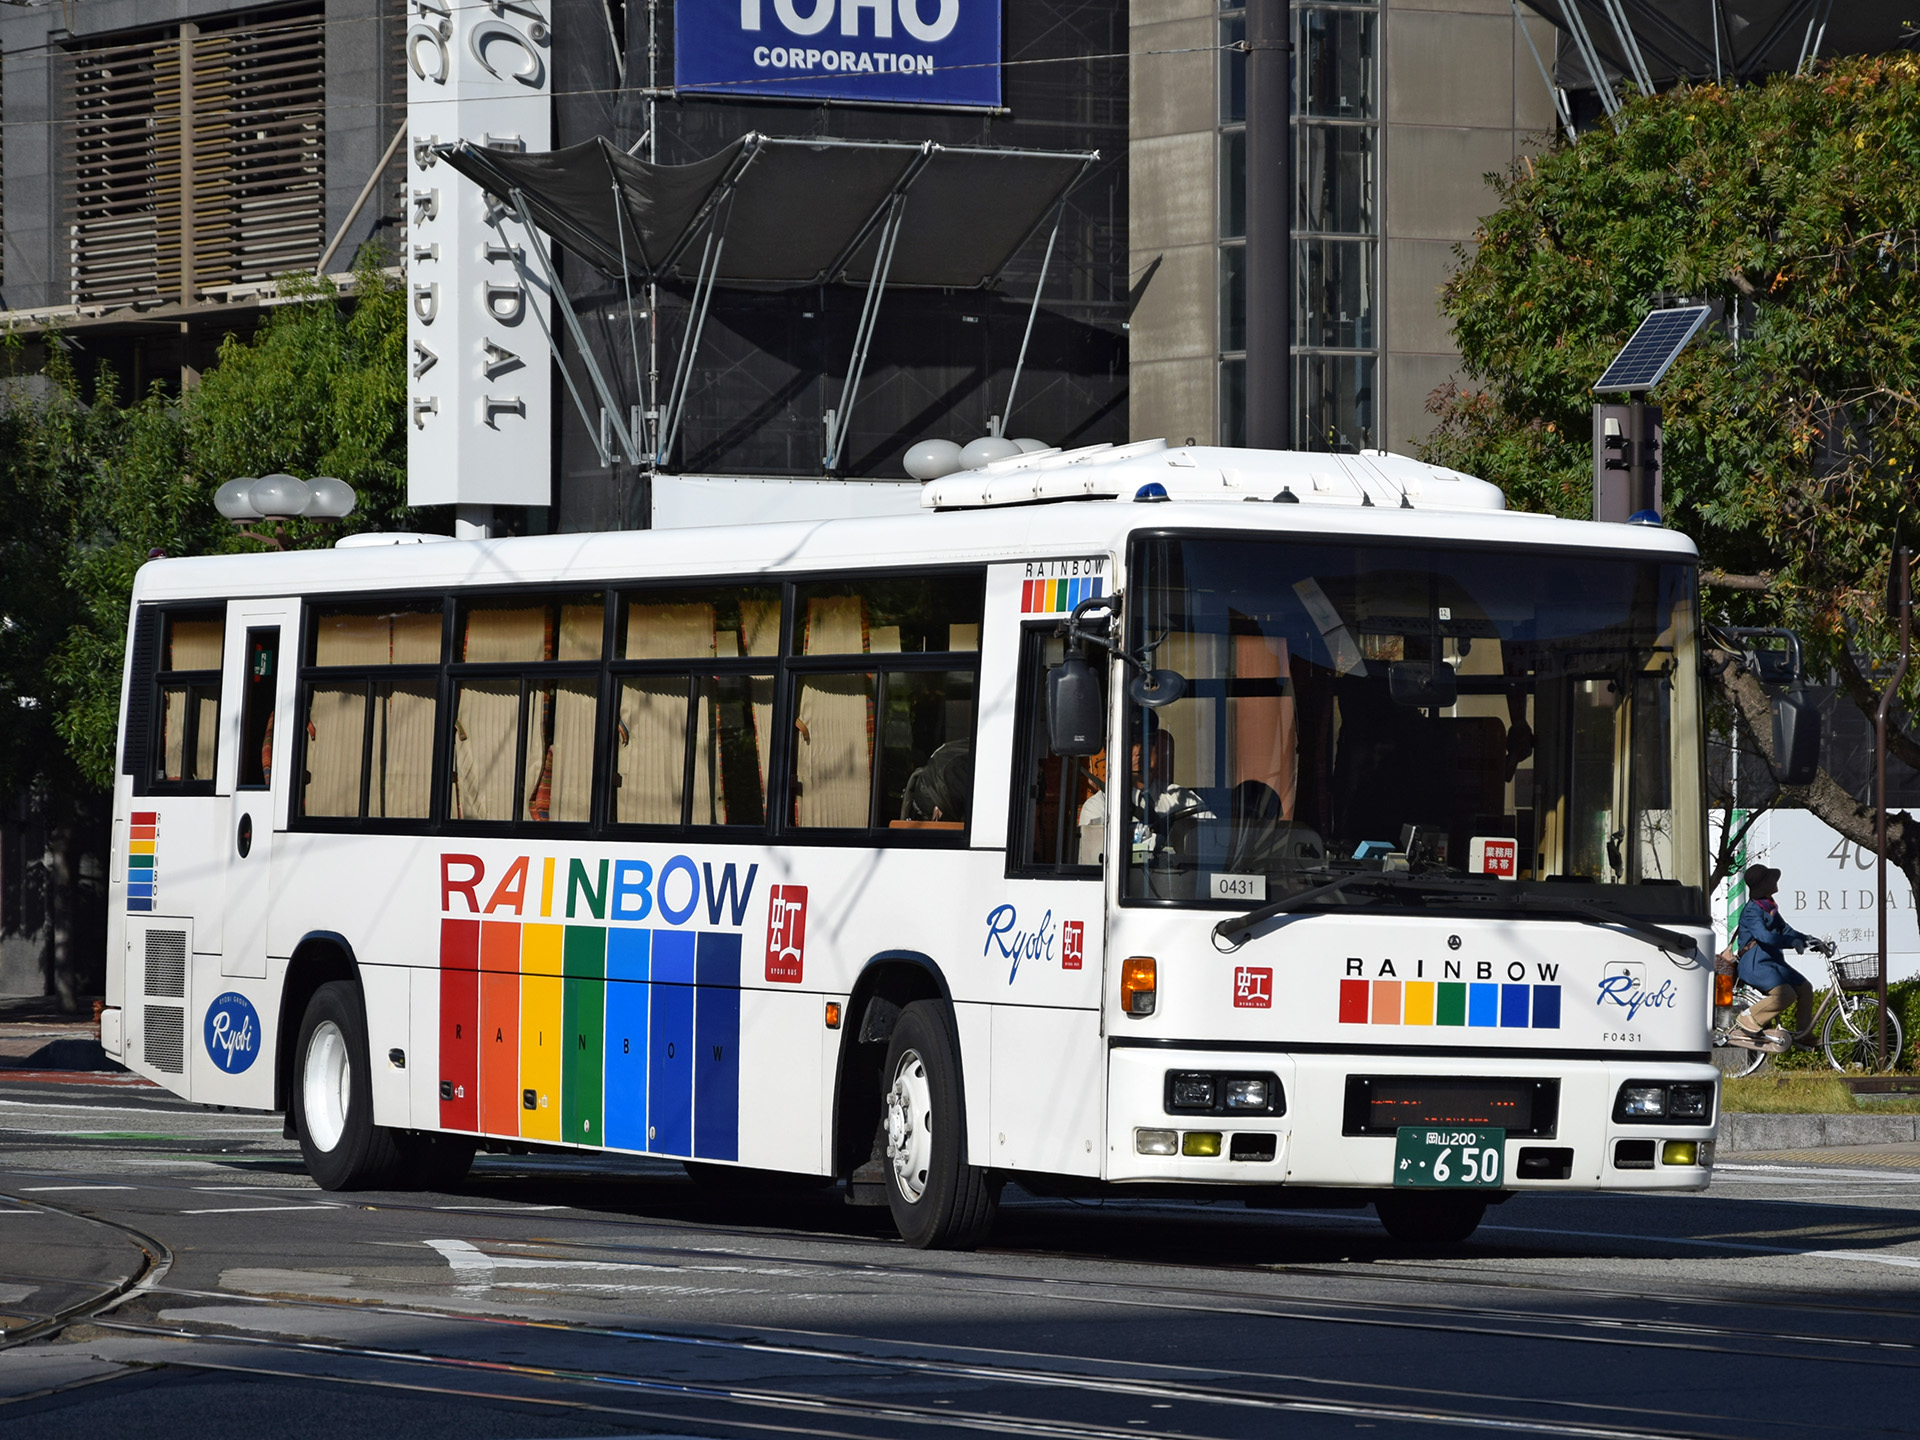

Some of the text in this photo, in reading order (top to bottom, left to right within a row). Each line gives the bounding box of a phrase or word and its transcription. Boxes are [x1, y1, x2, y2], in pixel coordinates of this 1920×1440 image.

[753, 46, 934, 75] CORPORATION
[413, 135, 439, 430] BRIDAL
[1025, 559, 1105, 578] RAINBOW
[1486, 847, 1513, 858] 業務用
[1488, 859, 1509, 869] 携帯
[440, 853, 759, 927] RAINBOW
[1220, 879, 1254, 895] 0431
[1794, 889, 1918, 911] BRIDAL
[769, 884, 803, 962] 虹
[1839, 928, 1875, 942] 営業中
[984, 904, 1056, 986] Ryobi
[1237, 966, 1270, 1001] 虹
[1346, 957, 1559, 982] RAINBOW
[1597, 976, 1677, 1021] Ryobi
[212, 1011, 252, 1069] Ryobi
[455, 1024, 723, 1062] RAINBOW
